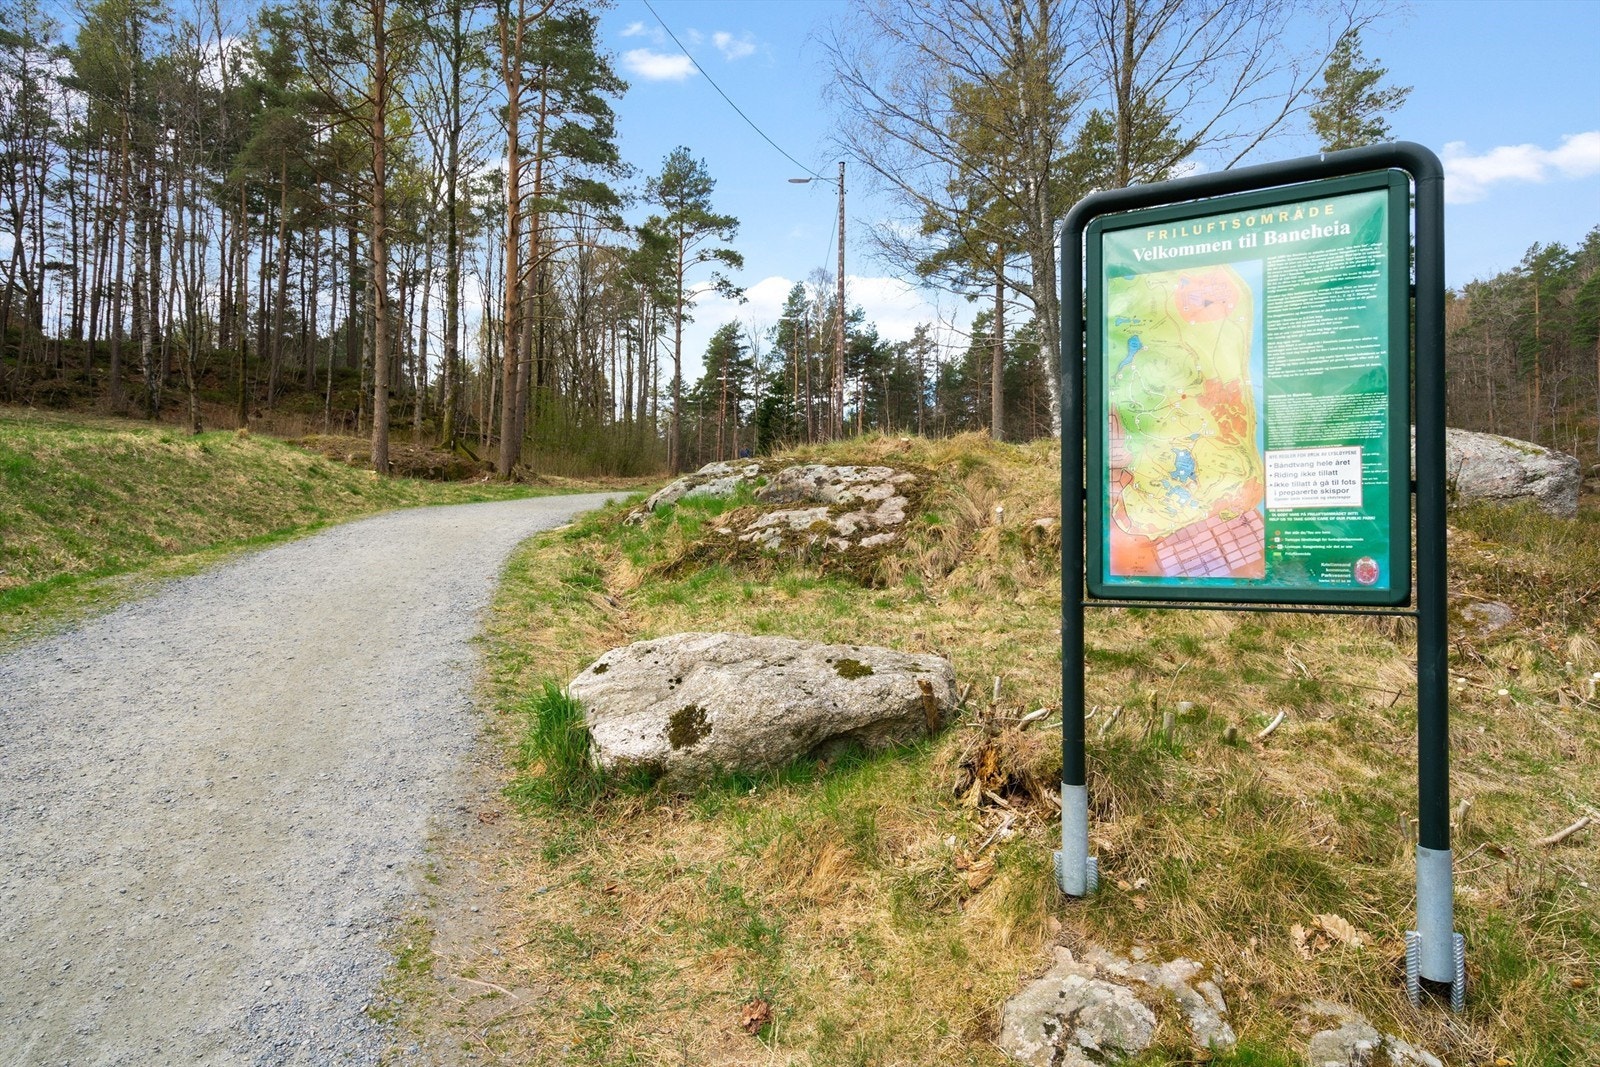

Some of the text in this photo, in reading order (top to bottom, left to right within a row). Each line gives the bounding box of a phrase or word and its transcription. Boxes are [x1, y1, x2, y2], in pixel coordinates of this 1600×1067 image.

[1147, 204, 1335, 242] FRILUFTSOMRÅDE
[1133, 220, 1351, 263] Velkommen til Baneheia
[1273, 460, 1314, 469] Båndtvang
[1274, 471, 1299, 479] Riding
[1319, 479, 1330, 488] gå
[1278, 488, 1318, 497] preparerte
[1320, 487, 1350, 496] skispor
